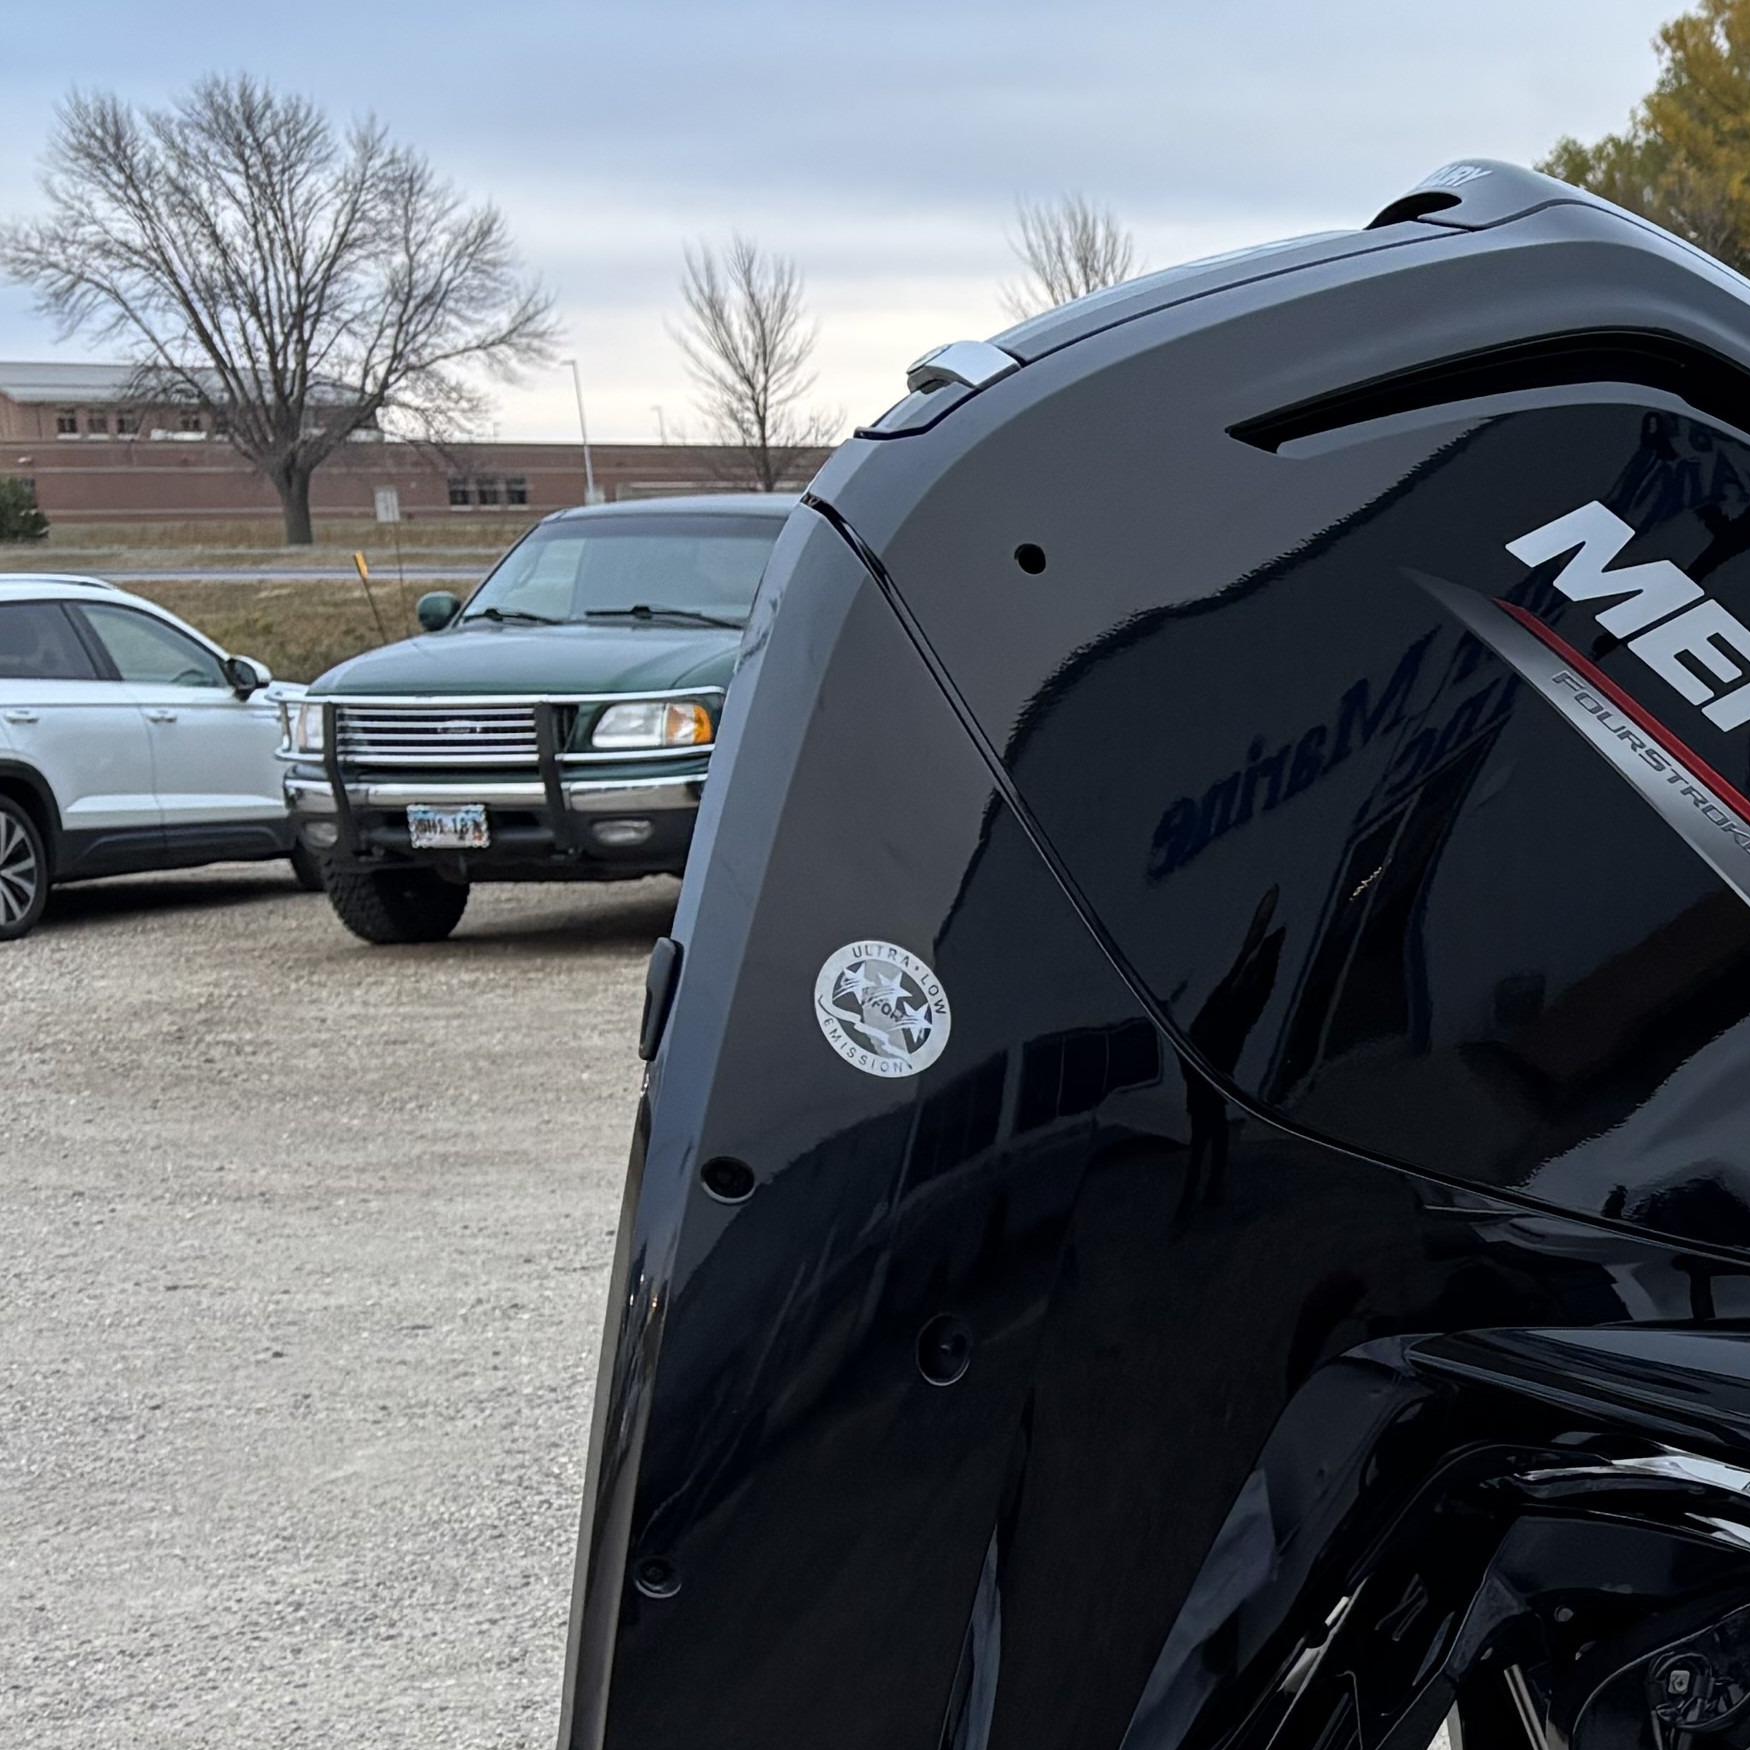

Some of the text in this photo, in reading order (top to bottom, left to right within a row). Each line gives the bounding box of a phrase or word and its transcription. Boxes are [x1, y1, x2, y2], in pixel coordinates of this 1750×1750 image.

[851, 944, 911, 968] ULTRA
[920, 974, 948, 1015] LOW
[823, 1017, 903, 1073] EMISSION
